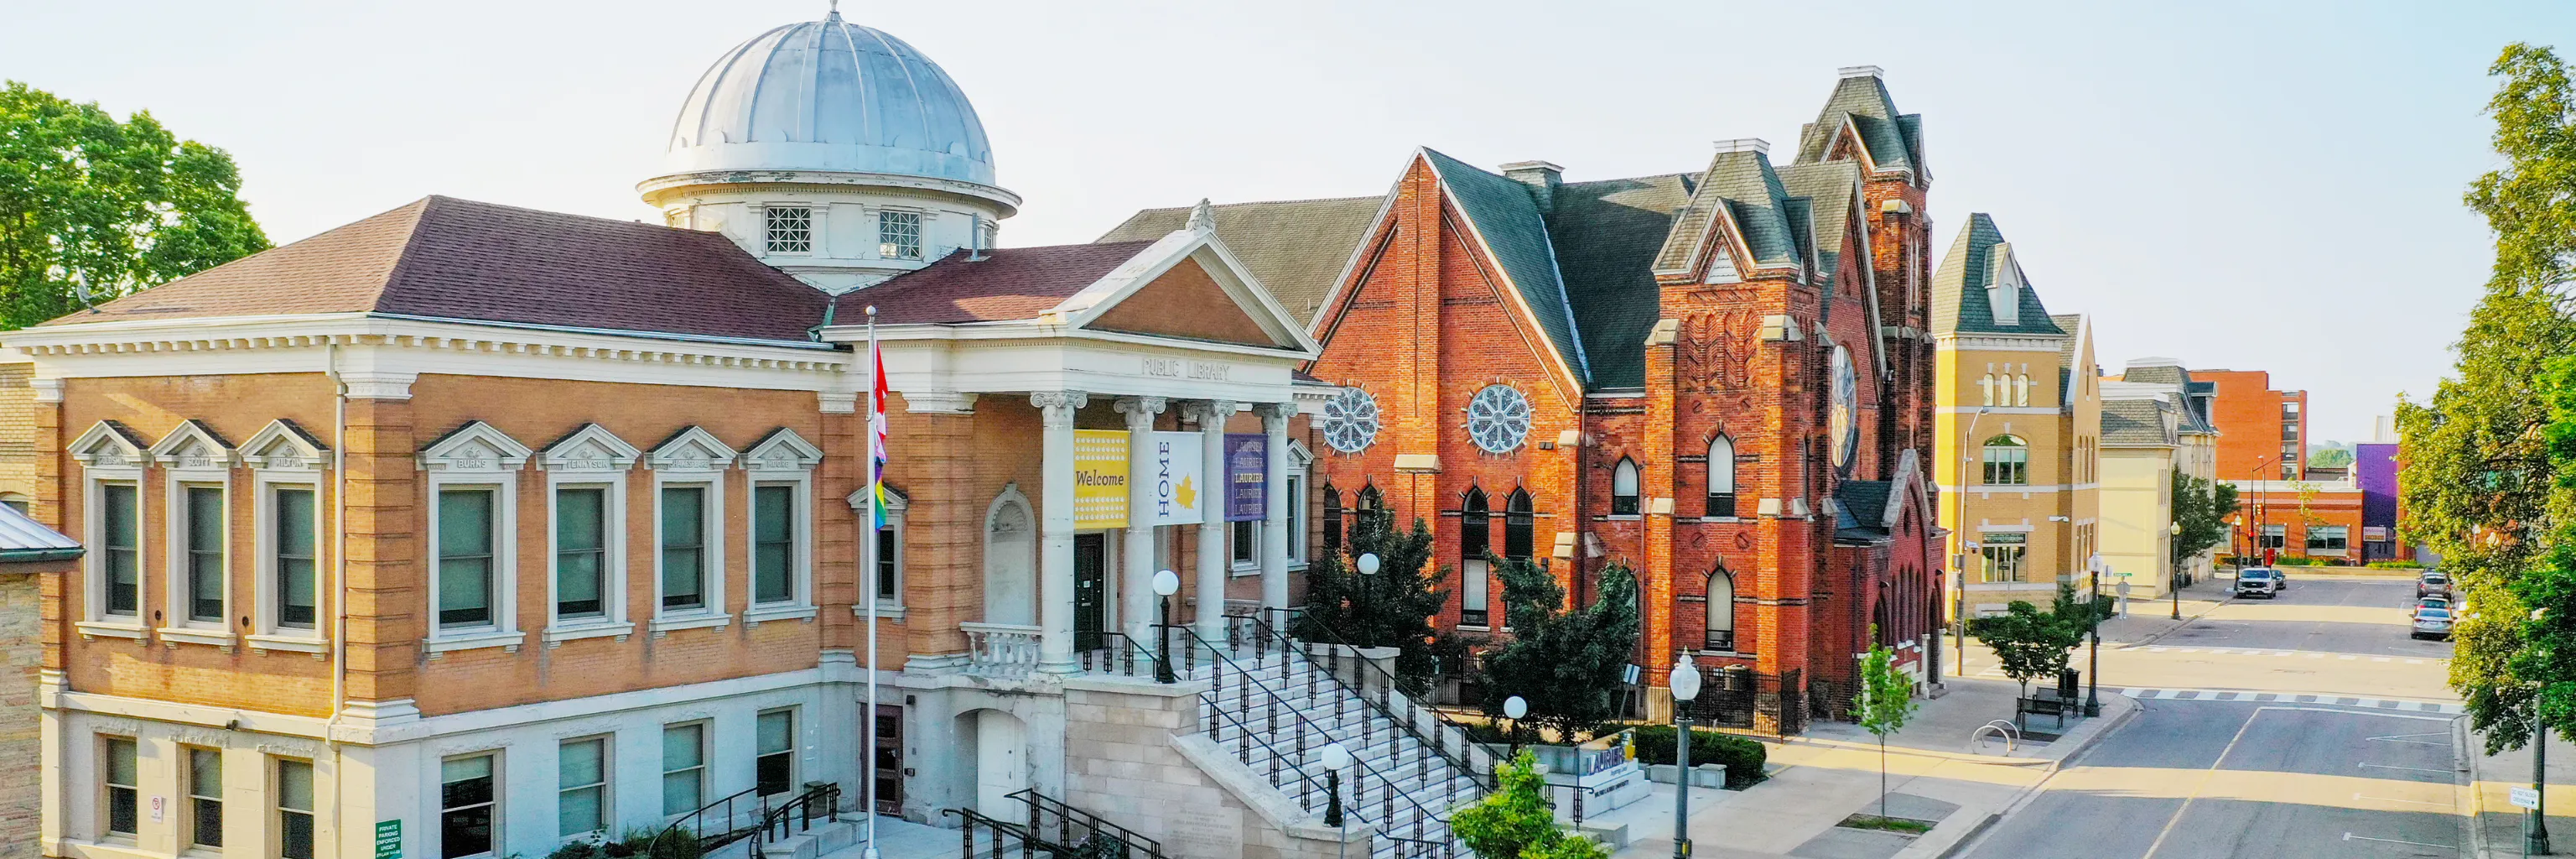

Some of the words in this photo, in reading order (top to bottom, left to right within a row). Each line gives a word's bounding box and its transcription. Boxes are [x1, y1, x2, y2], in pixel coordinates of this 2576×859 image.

[1141, 358, 1180, 377] PUBLIC
[1187, 361, 1229, 381] LIBRARY
[1235, 441, 1264, 452] LAURIER
[188, 458, 210, 466] SCOTT
[276, 458, 303, 467] MILTON
[457, 460, 487, 469] BURNS
[566, 460, 608, 469] TENNYSON
[1235, 457, 1264, 468] LAURIER
[1076, 470, 1124, 486] Welcome
[1159, 441, 1170, 518] HOME
[1235, 473, 1264, 484] LAURIER
[1235, 488, 1262, 499] LAURIER
[1234, 503, 1264, 514] LAURIER
[1589, 747, 1625, 775] LAURIER
